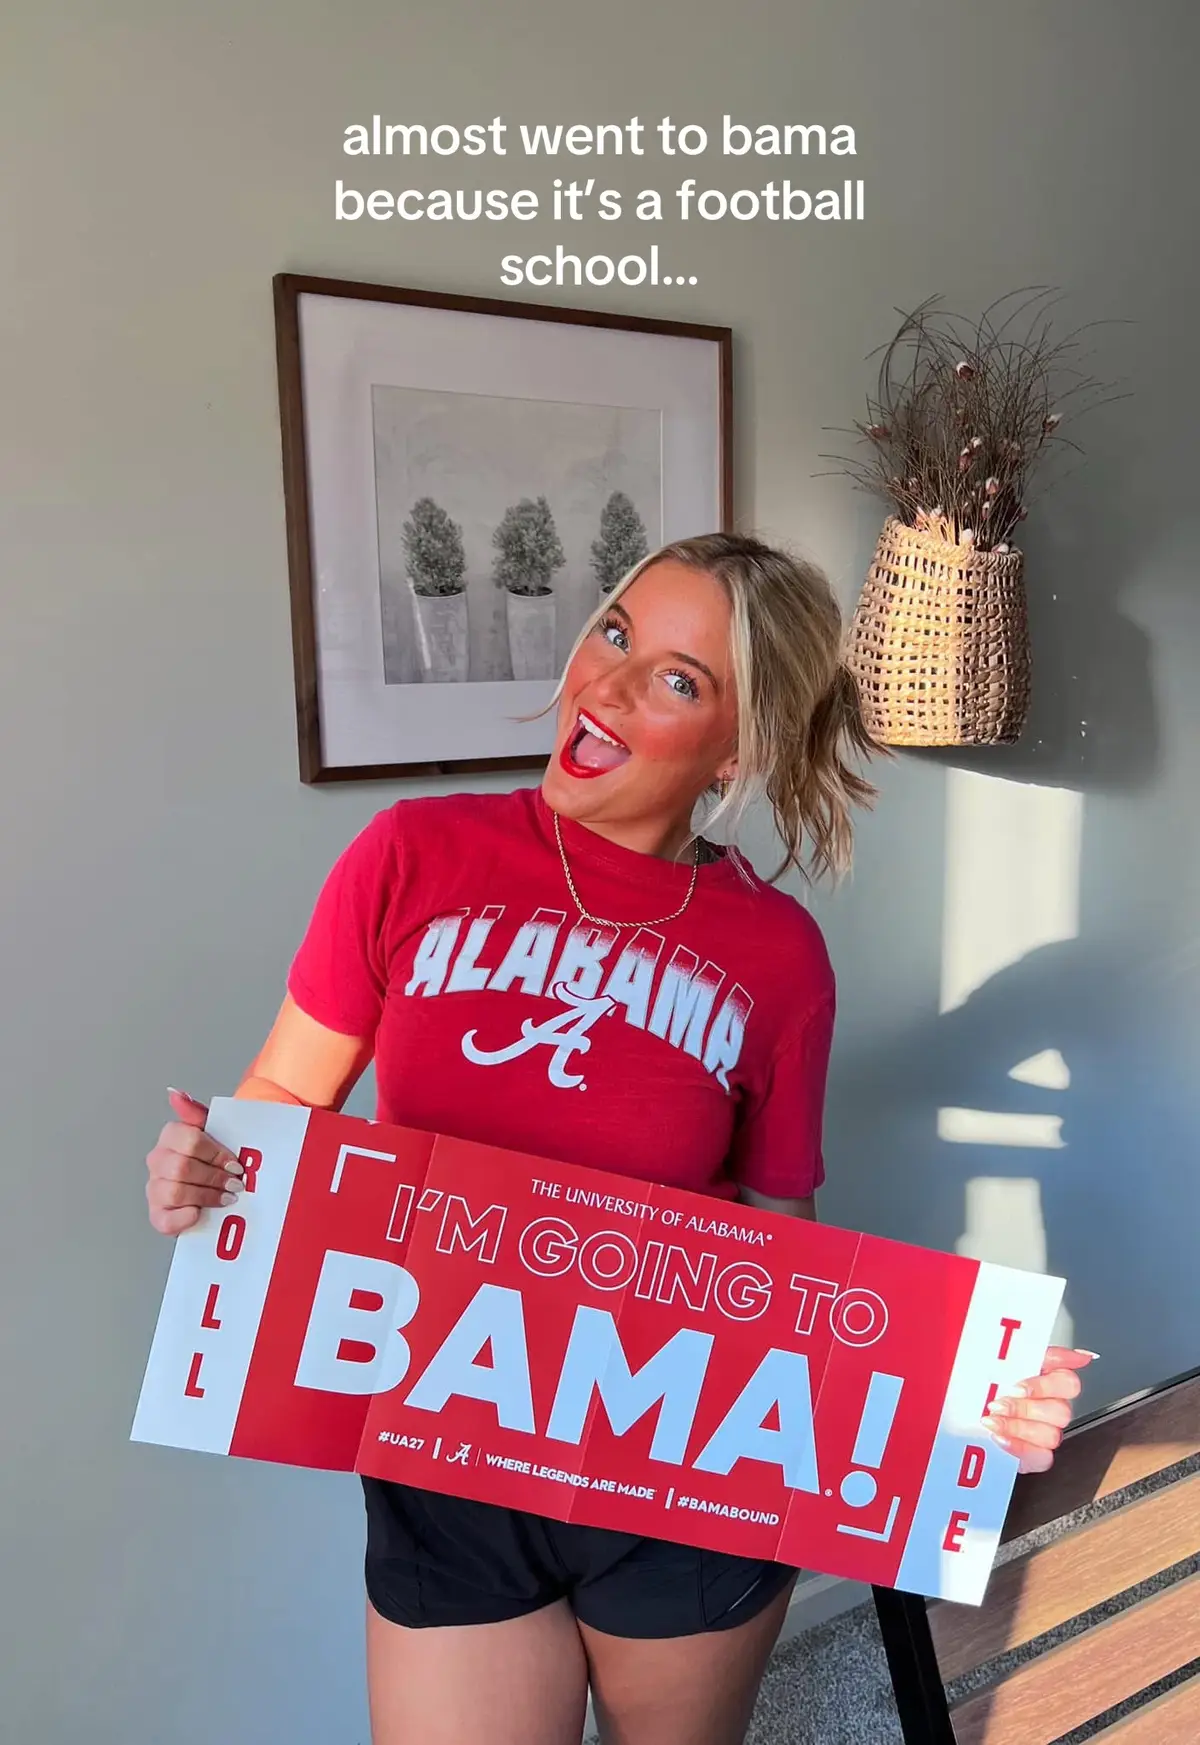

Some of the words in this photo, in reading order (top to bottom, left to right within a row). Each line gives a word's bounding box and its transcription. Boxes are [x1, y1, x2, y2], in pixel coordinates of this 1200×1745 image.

[404, 904, 755, 1097] ALABAMA
[531, 1178, 562, 1199] THE
[565, 1187, 660, 1221] UNIVERSITY
[661, 1210, 685, 1227] OF
[183, 1146, 263, 1399] ROLL
[518, 1216, 773, 1321] GOING
[789, 1273, 889, 1347] TO
[293, 1249, 905, 1508] BAMA!
[378, 1431, 425, 1451] #UA27
[486, 1453, 531, 1475] WHERE
[532, 1465, 590, 1489] LEGENDS
[590, 1477, 617, 1493] ARE
[617, 1482, 656, 1501] MADE
[677, 1496, 780, 1526] #BAMABOUND
